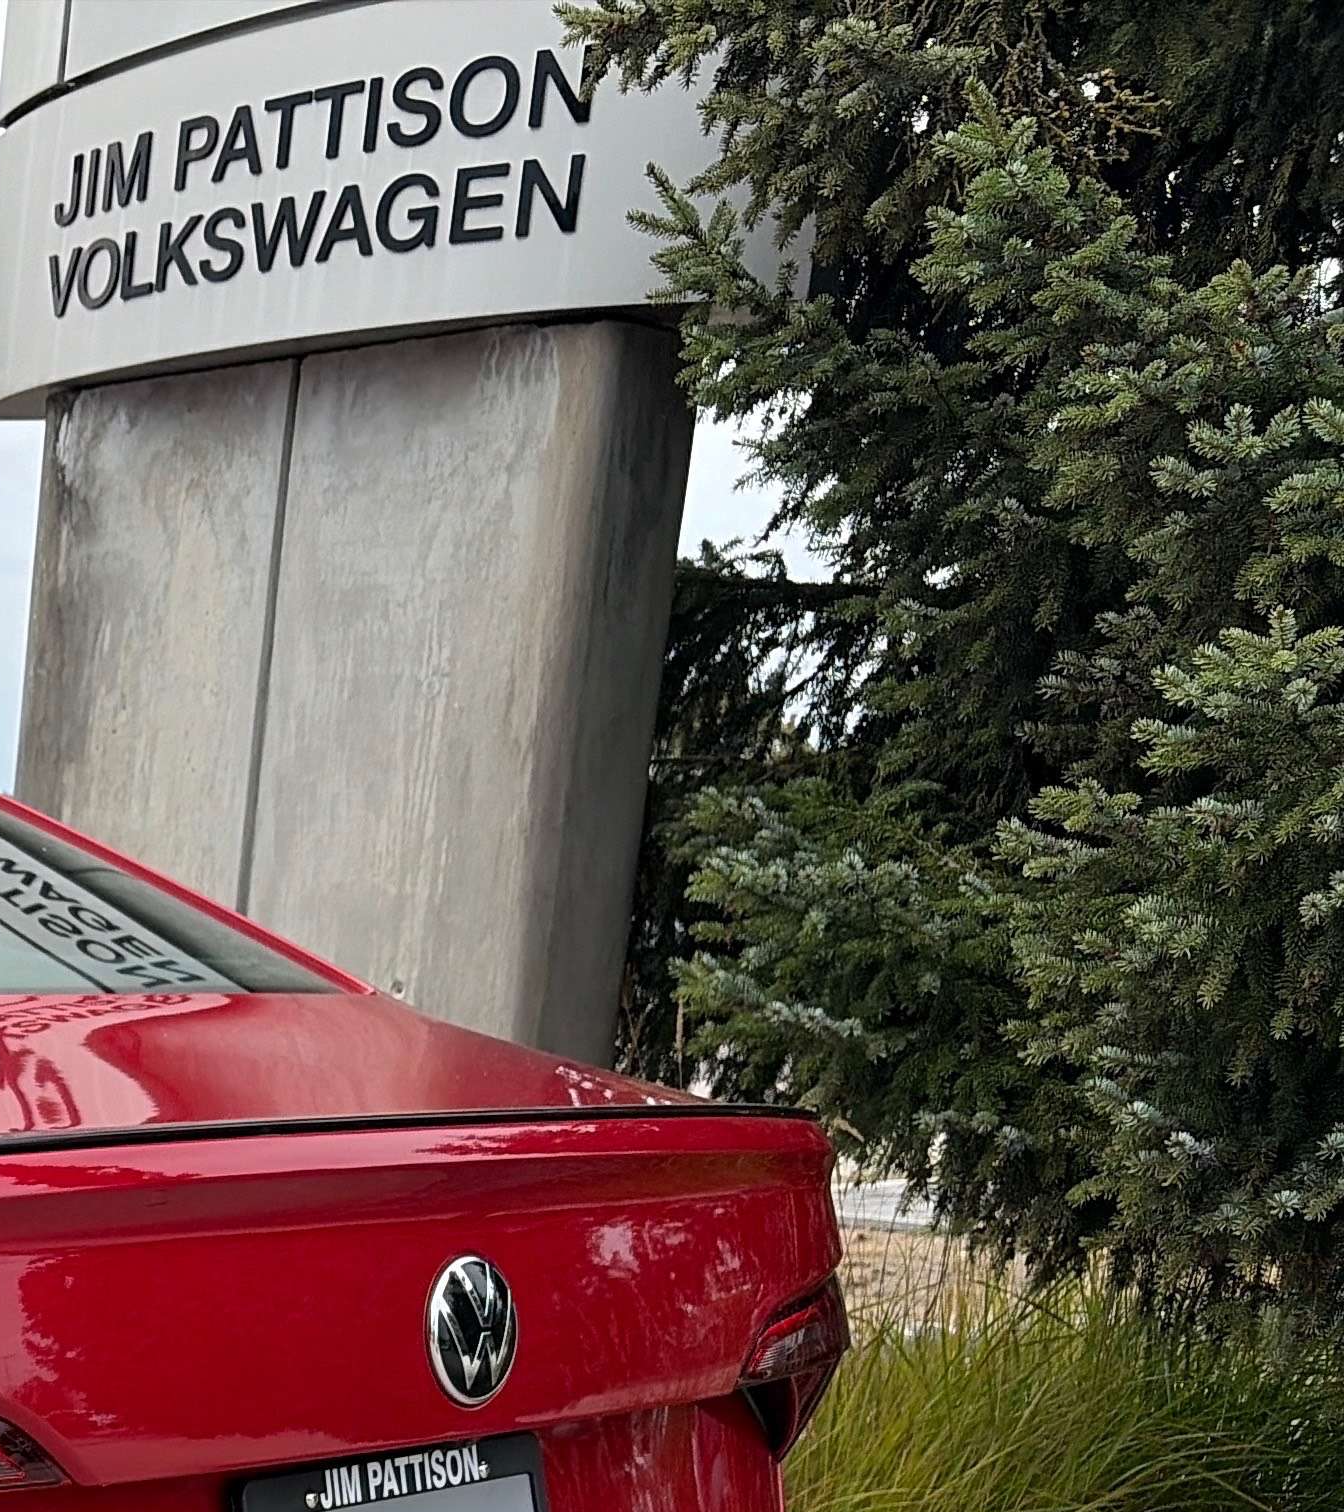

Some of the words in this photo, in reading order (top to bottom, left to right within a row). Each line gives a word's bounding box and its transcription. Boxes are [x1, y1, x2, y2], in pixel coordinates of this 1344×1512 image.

[54, 130, 154, 227] JIM
[174, 44, 595, 192] PATTISON
[48, 153, 587, 318] VOLKSWAGEN
[320, 1468, 362, 1510] JIM
[367, 1445, 481, 1501] PATTISON
